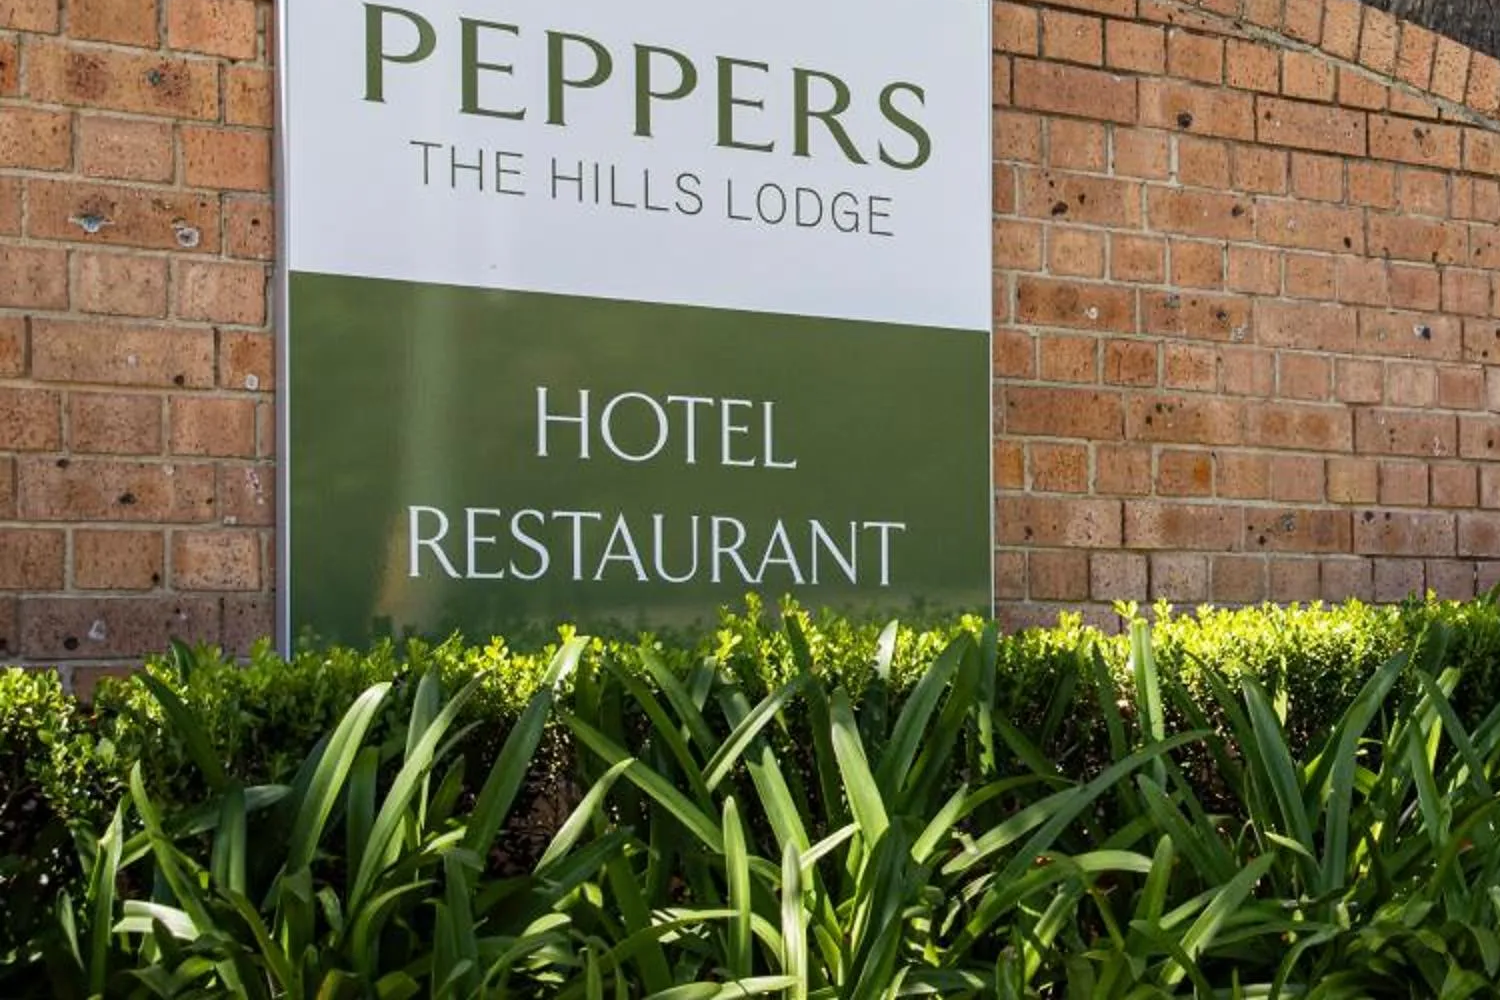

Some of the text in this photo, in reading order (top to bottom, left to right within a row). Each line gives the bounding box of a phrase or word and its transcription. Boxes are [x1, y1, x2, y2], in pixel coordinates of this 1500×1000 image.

[361, 1, 932, 172] PEPPERS
[409, 140, 895, 238] THE HILLS LODGE
[535, 386, 798, 470] HOTEL
[407, 504, 907, 587] RESTAURANT
